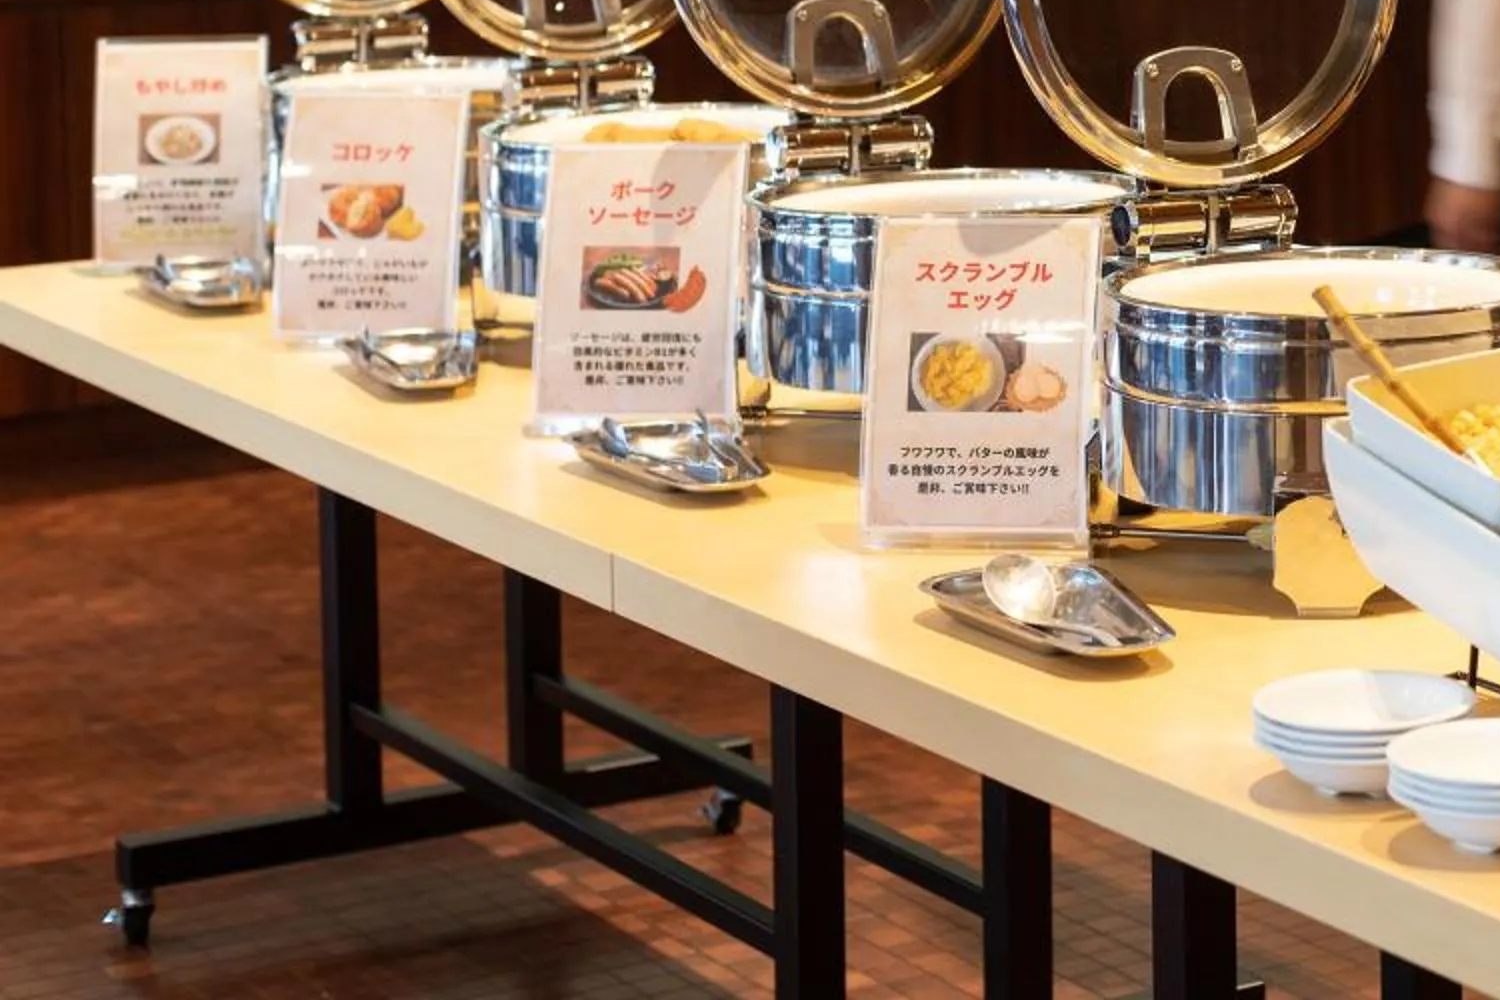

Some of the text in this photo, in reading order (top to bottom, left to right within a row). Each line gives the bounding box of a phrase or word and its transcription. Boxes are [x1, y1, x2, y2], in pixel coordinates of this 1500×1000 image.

[332, 142, 416, 162] コロッケ
[611, 180, 676, 201] ポーク
[588, 206, 698, 226] ソーセージ
[915, 261, 1053, 283] スクランブル
[947, 288, 1018, 311] エッグ
[900, 446, 1050, 459] フワフワで、バターの風味が
